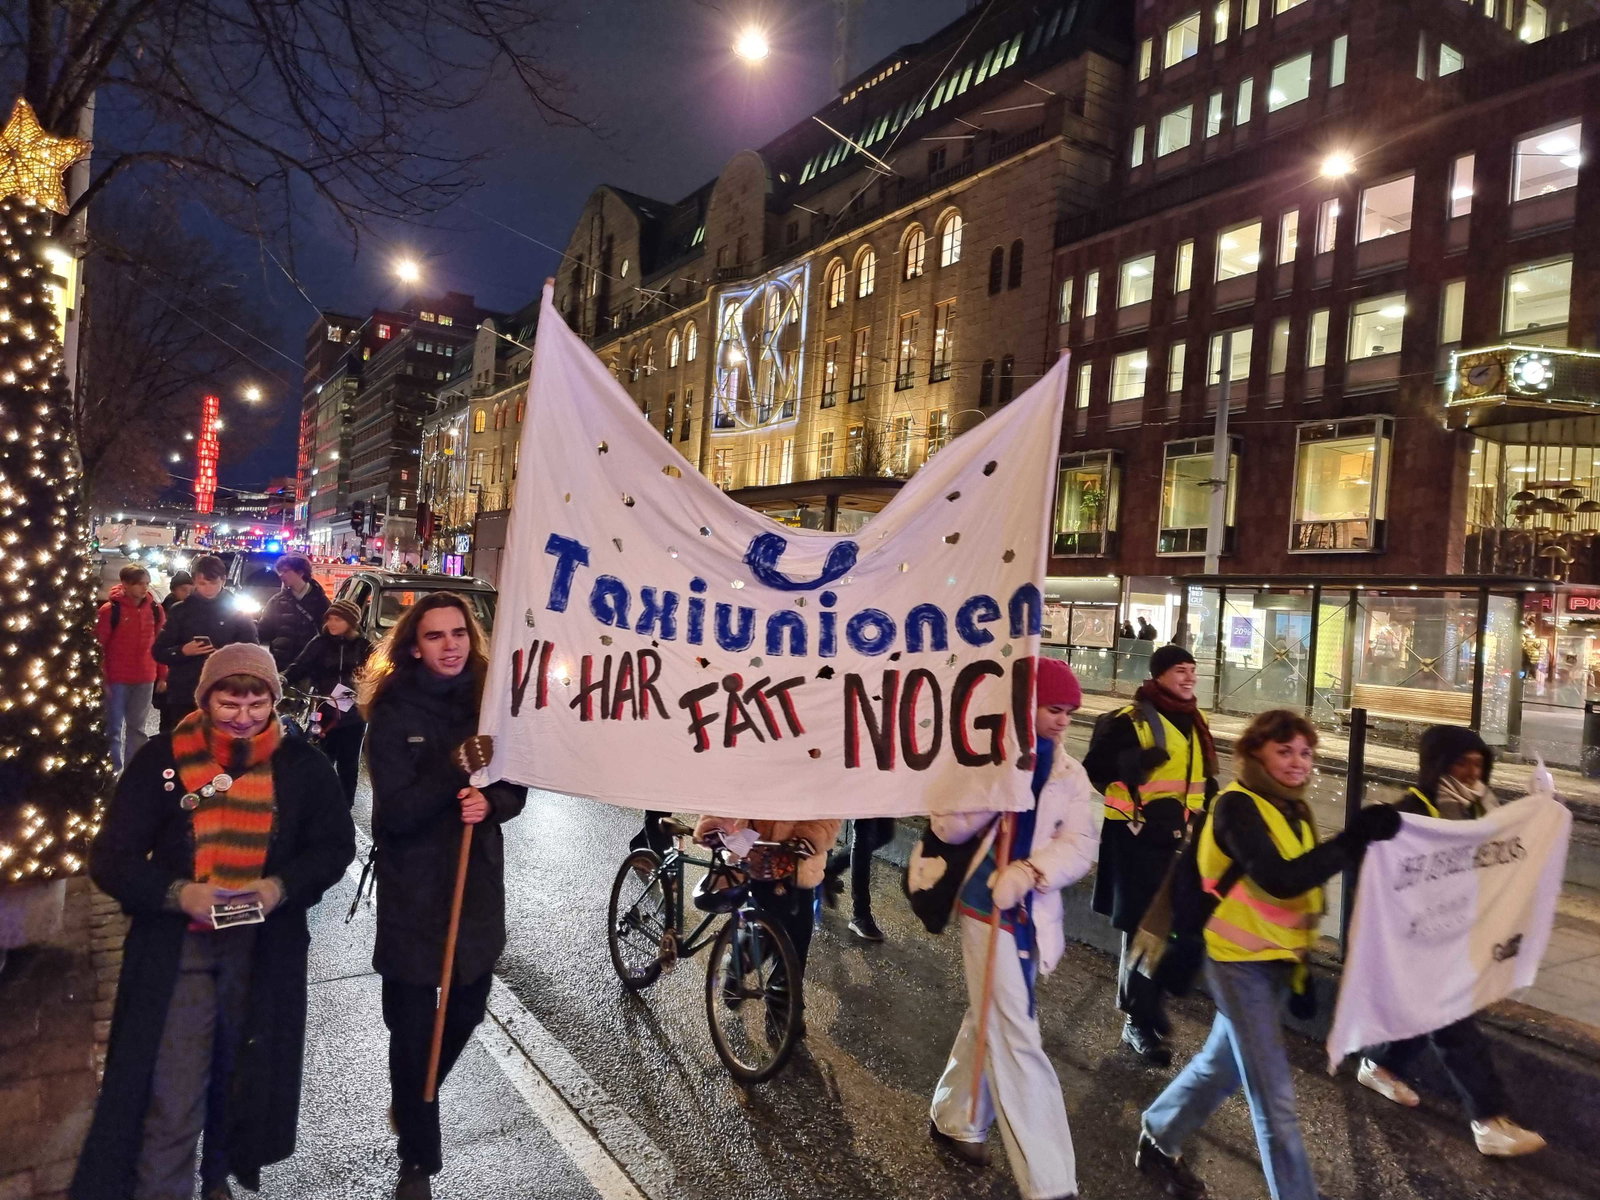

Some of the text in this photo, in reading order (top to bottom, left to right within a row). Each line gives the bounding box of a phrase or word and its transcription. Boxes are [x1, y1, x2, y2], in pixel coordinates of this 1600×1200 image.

[544, 533, 1042, 658] Taxiunionen
[511, 639, 1037, 772] VI HAR FÅTT NOG!
